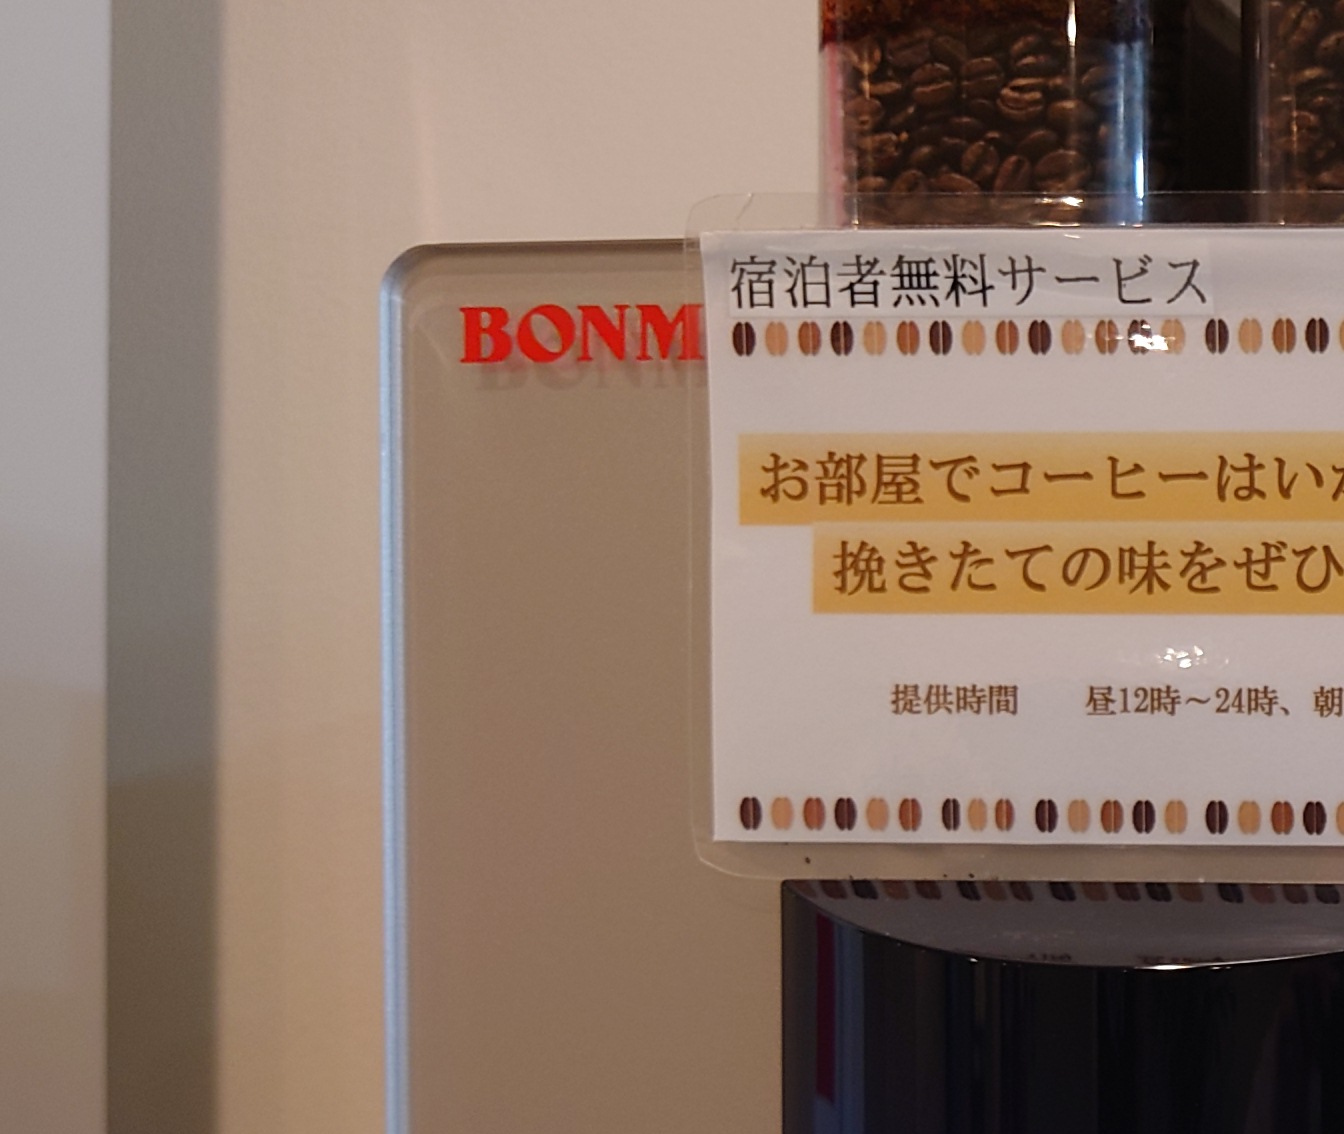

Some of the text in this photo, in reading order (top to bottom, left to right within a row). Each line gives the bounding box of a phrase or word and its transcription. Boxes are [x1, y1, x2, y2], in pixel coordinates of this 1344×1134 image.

[729, 253, 1207, 310] 宿泊者無料サービス
[458, 302, 705, 364] BONM
[890, 684, 1019, 717] 提供時間
